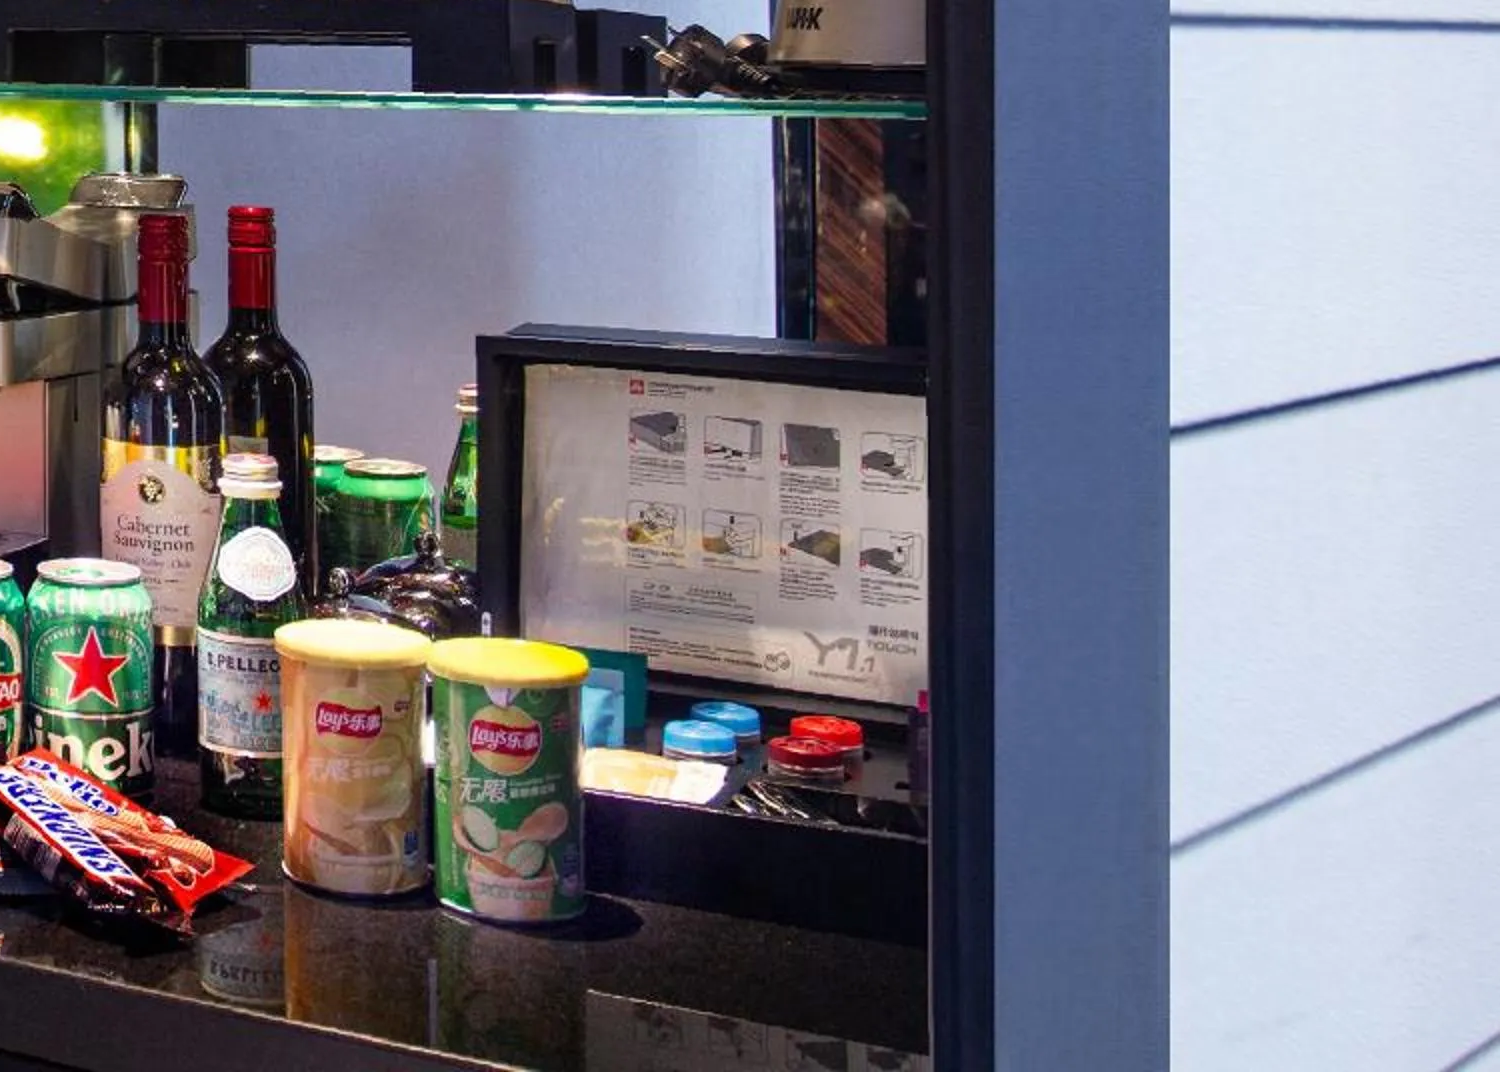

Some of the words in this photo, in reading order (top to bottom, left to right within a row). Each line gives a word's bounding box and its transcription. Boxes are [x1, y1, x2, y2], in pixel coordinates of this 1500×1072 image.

[116, 514, 192, 537] Cabernet
[114, 530, 196, 557] Sauvignon
[460, 778, 508, 804] 无限
